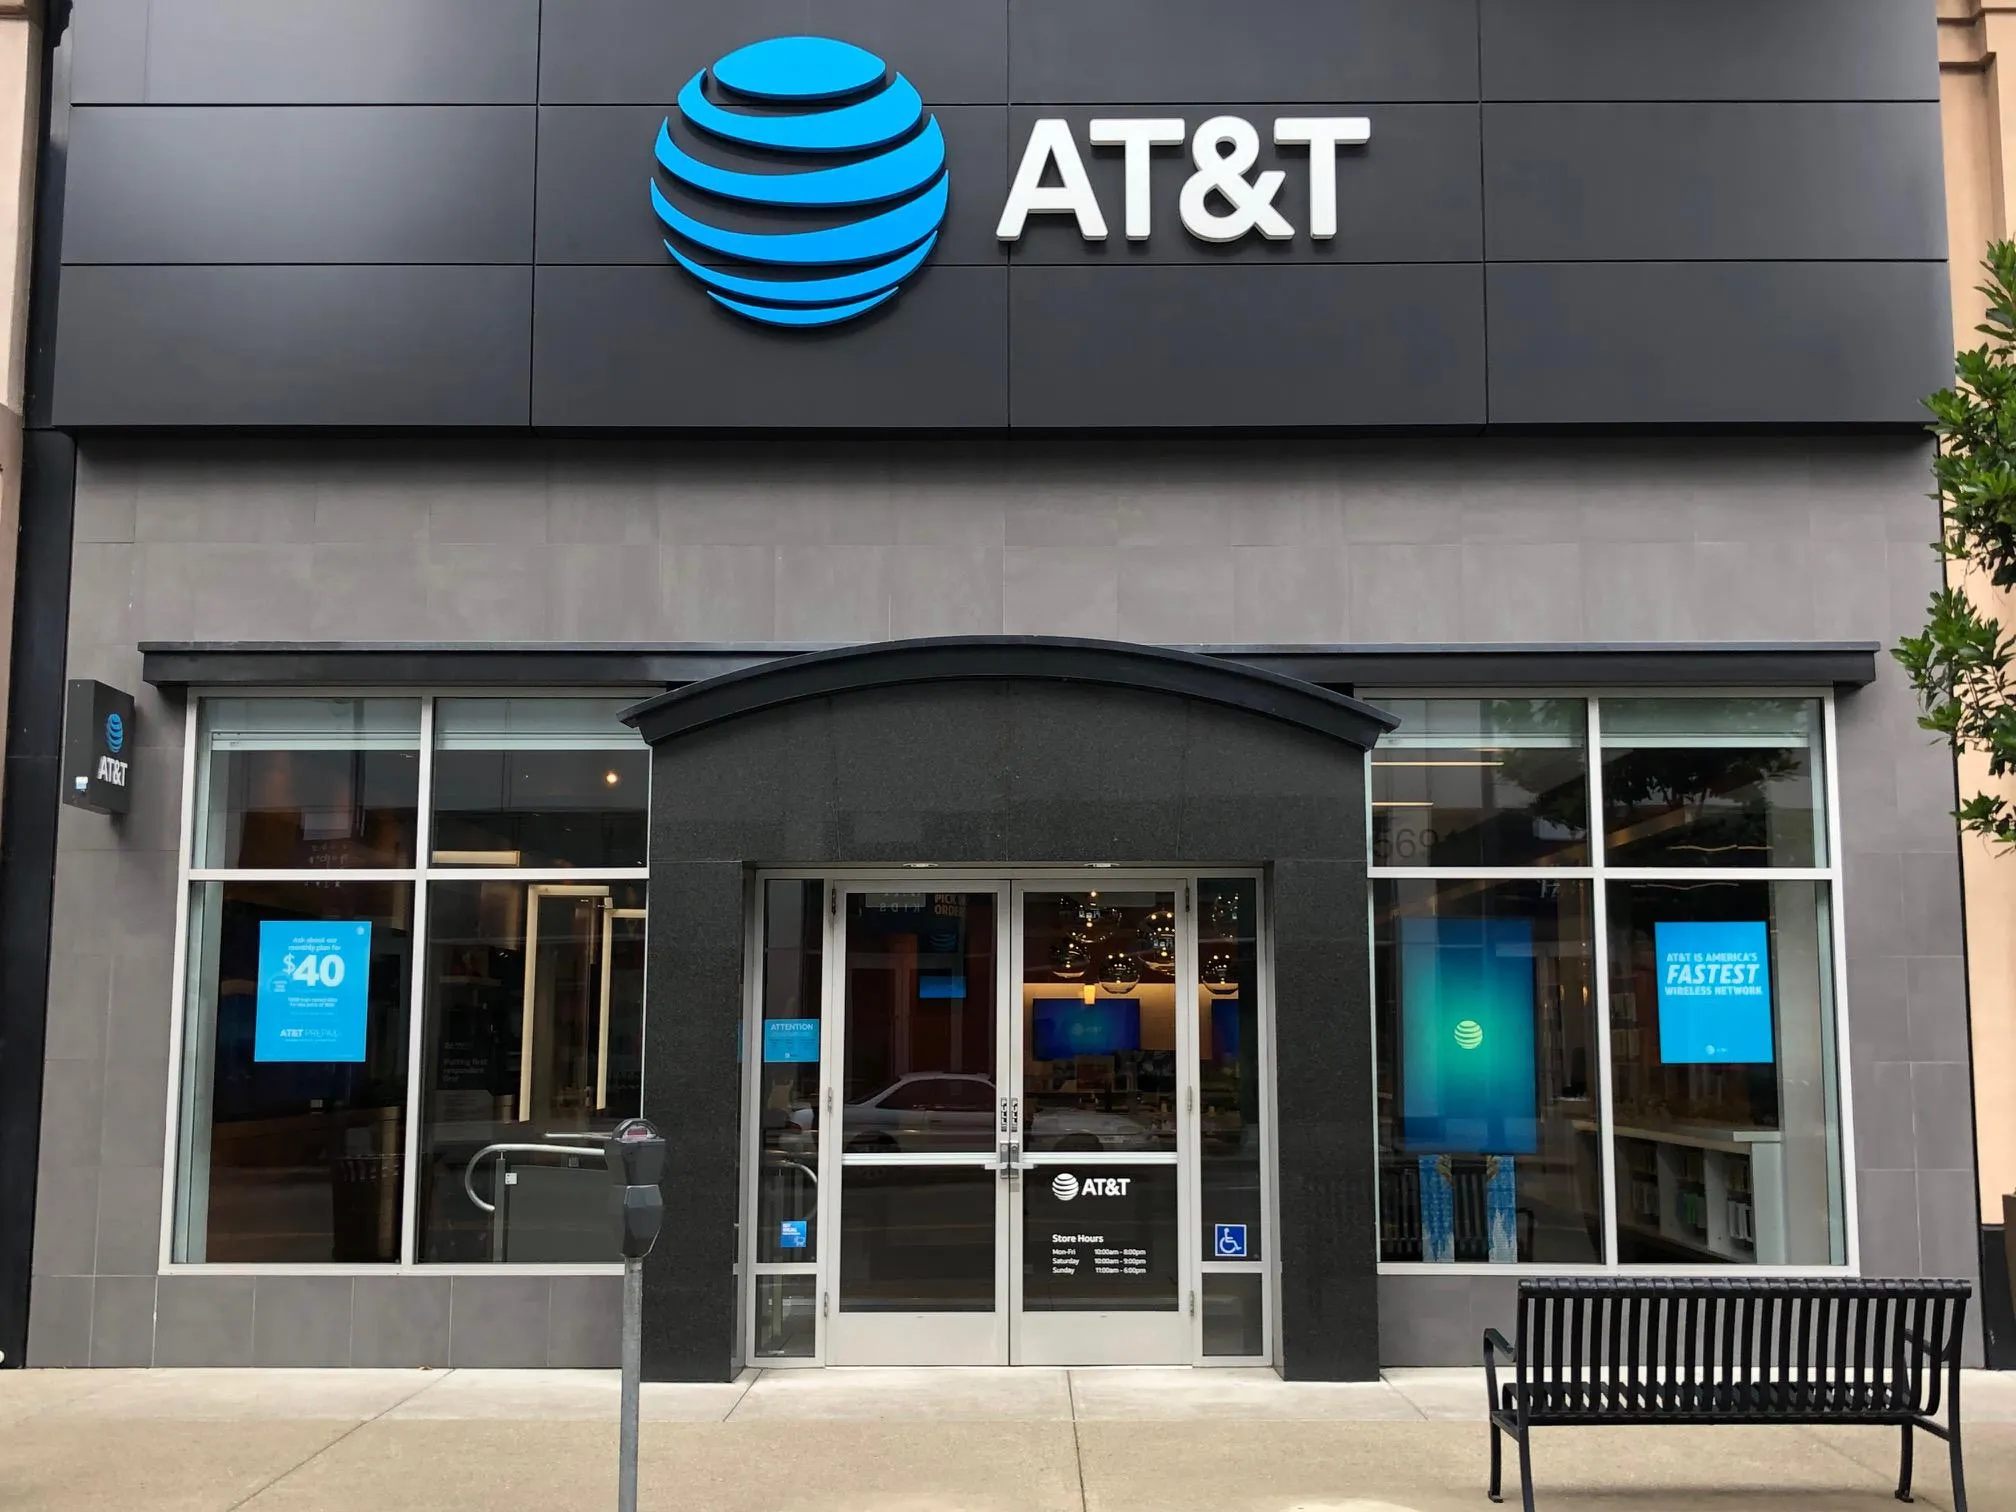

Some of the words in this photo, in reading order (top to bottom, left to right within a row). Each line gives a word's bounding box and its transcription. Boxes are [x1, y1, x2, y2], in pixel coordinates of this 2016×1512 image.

[995, 115, 1371, 244] AT&T
[97, 755, 128, 787] AT&T
[1666, 953, 1691, 962] AT&T
[1694, 953, 1703, 962] IS
[1705, 952, 1758, 962] AMERICA'S
[283, 953, 345, 988] $40
[1667, 964, 1760, 984] FASTEST
[1664, 986, 1712, 996] WIRELESS
[770, 1023, 814, 1031] ATTENTION
[280, 1029, 304, 1037] AT&T
[1081, 1178, 1131, 1196] AT&T
[1052, 1234, 1076, 1243] Store
[1077, 1234, 1104, 1243] Hours
[1052, 1258, 1080, 1266] Saturday
[1052, 1266, 1075, 1275] Sunday
[1123, 1267, 1147, 1275] 6:00pm
